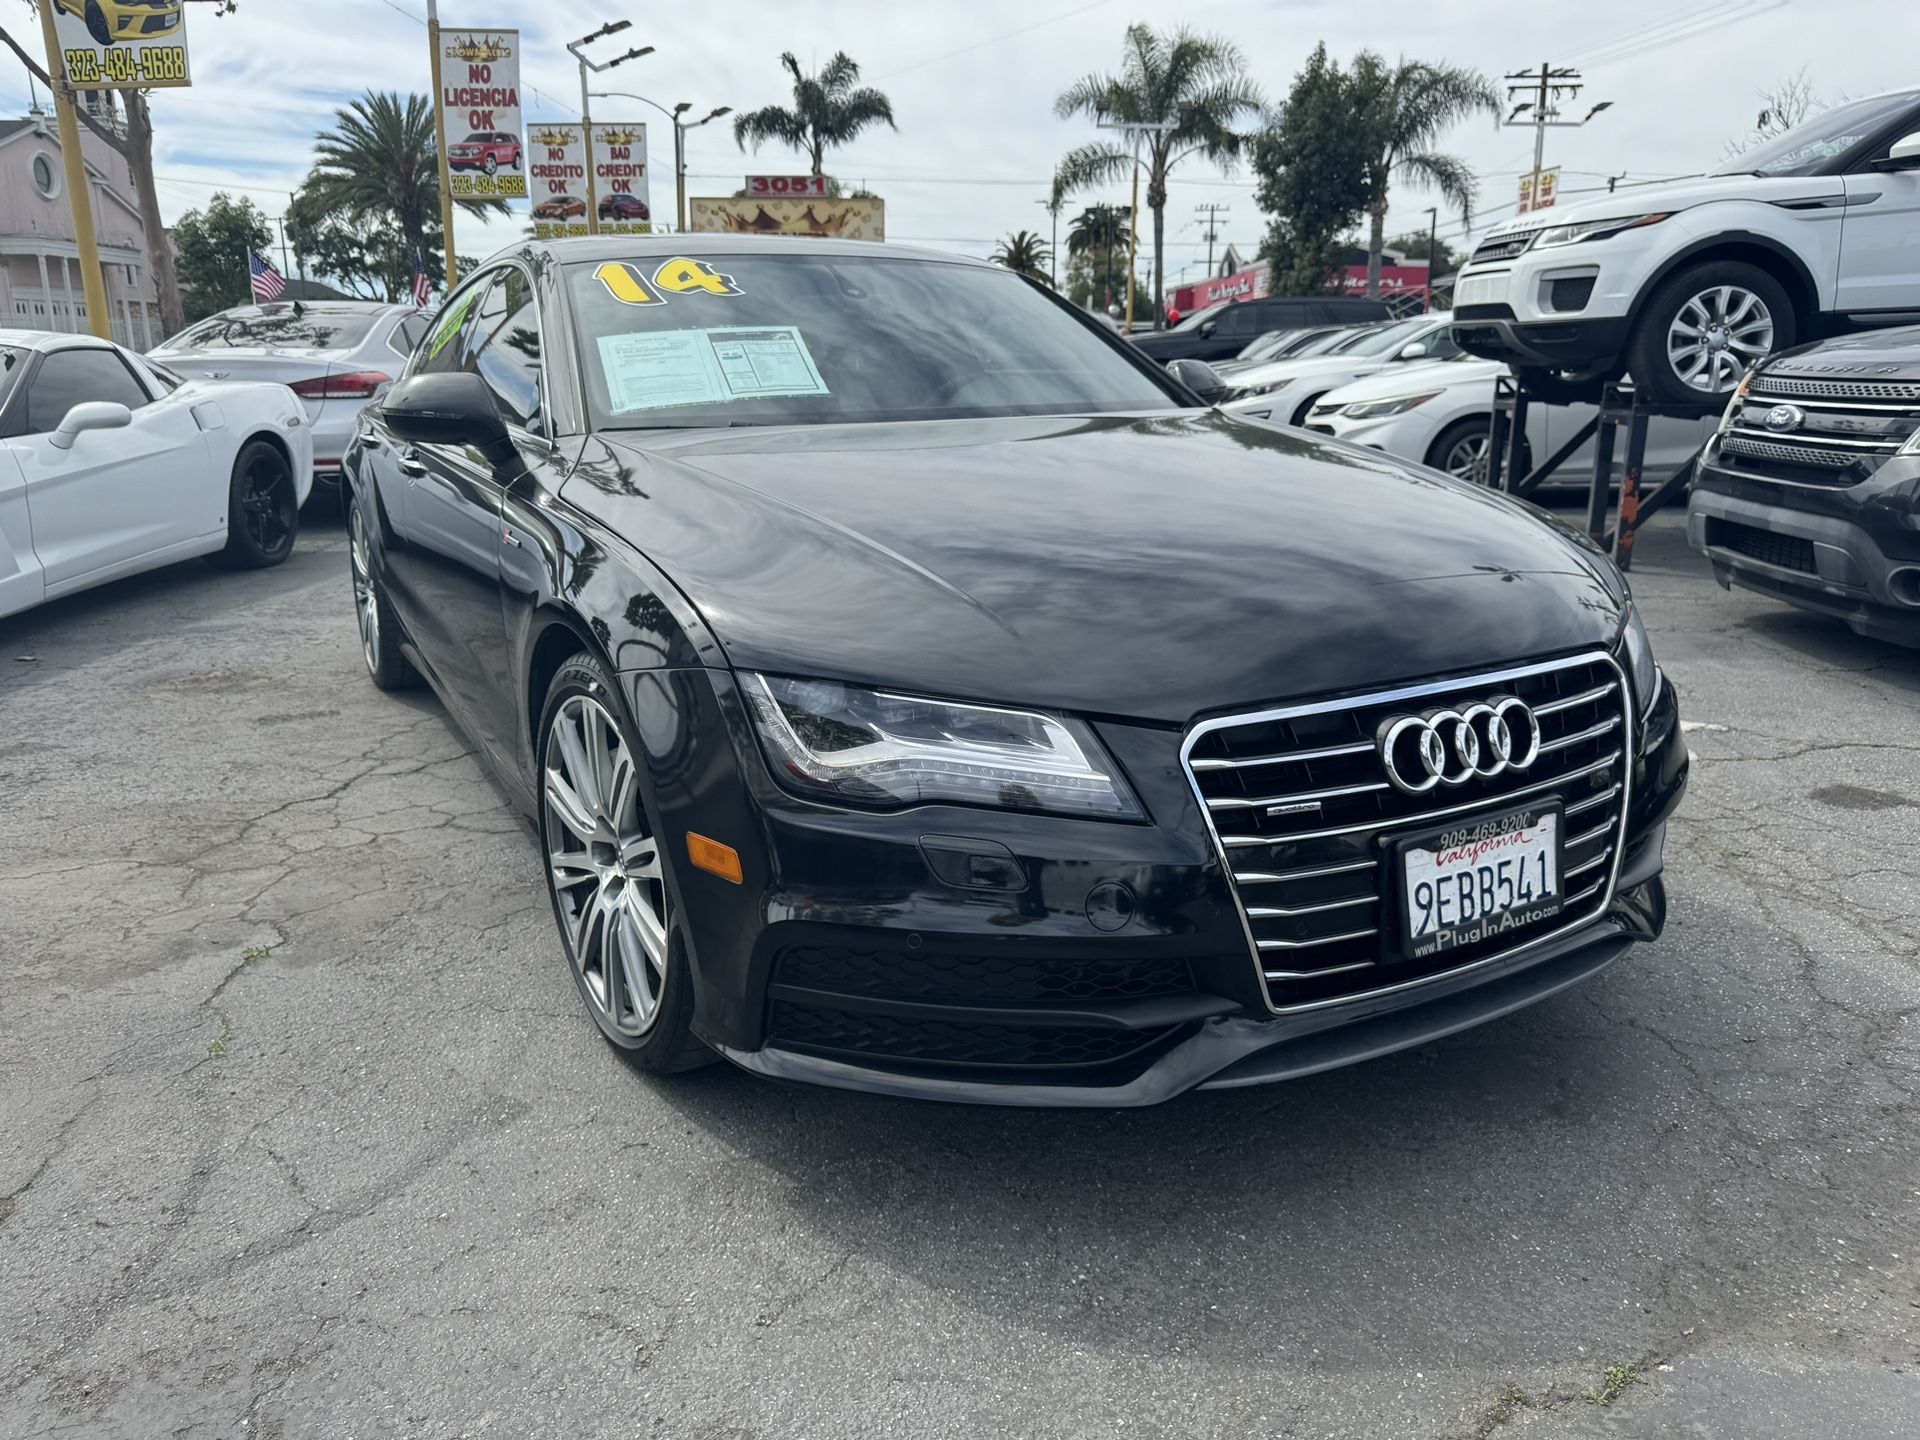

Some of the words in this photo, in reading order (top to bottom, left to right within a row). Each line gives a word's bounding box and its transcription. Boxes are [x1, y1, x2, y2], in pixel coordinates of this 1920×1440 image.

[65, 47, 186, 82] 323-484-9688
[468, 64, 491, 83] NO
[444, 88, 519, 107] LICENCIA
[469, 110, 495, 130] OK
[548, 148, 564, 161] NO
[610, 147, 630, 160] BAD
[531, 164, 584, 178] CREDITO
[597, 164, 645, 177] CREDIT
[451, 175, 525, 194] 323-484-9688
[549, 179, 567, 193] OK
[612, 179, 631, 193] OK
[752, 177, 824, 193] 3051
[592, 257, 747, 306] 14
[1436, 831, 1532, 867] California
[1414, 850, 1552, 937] 9EBB541
[1414, 904, 1559, 958] www.PlugInAuto.com
